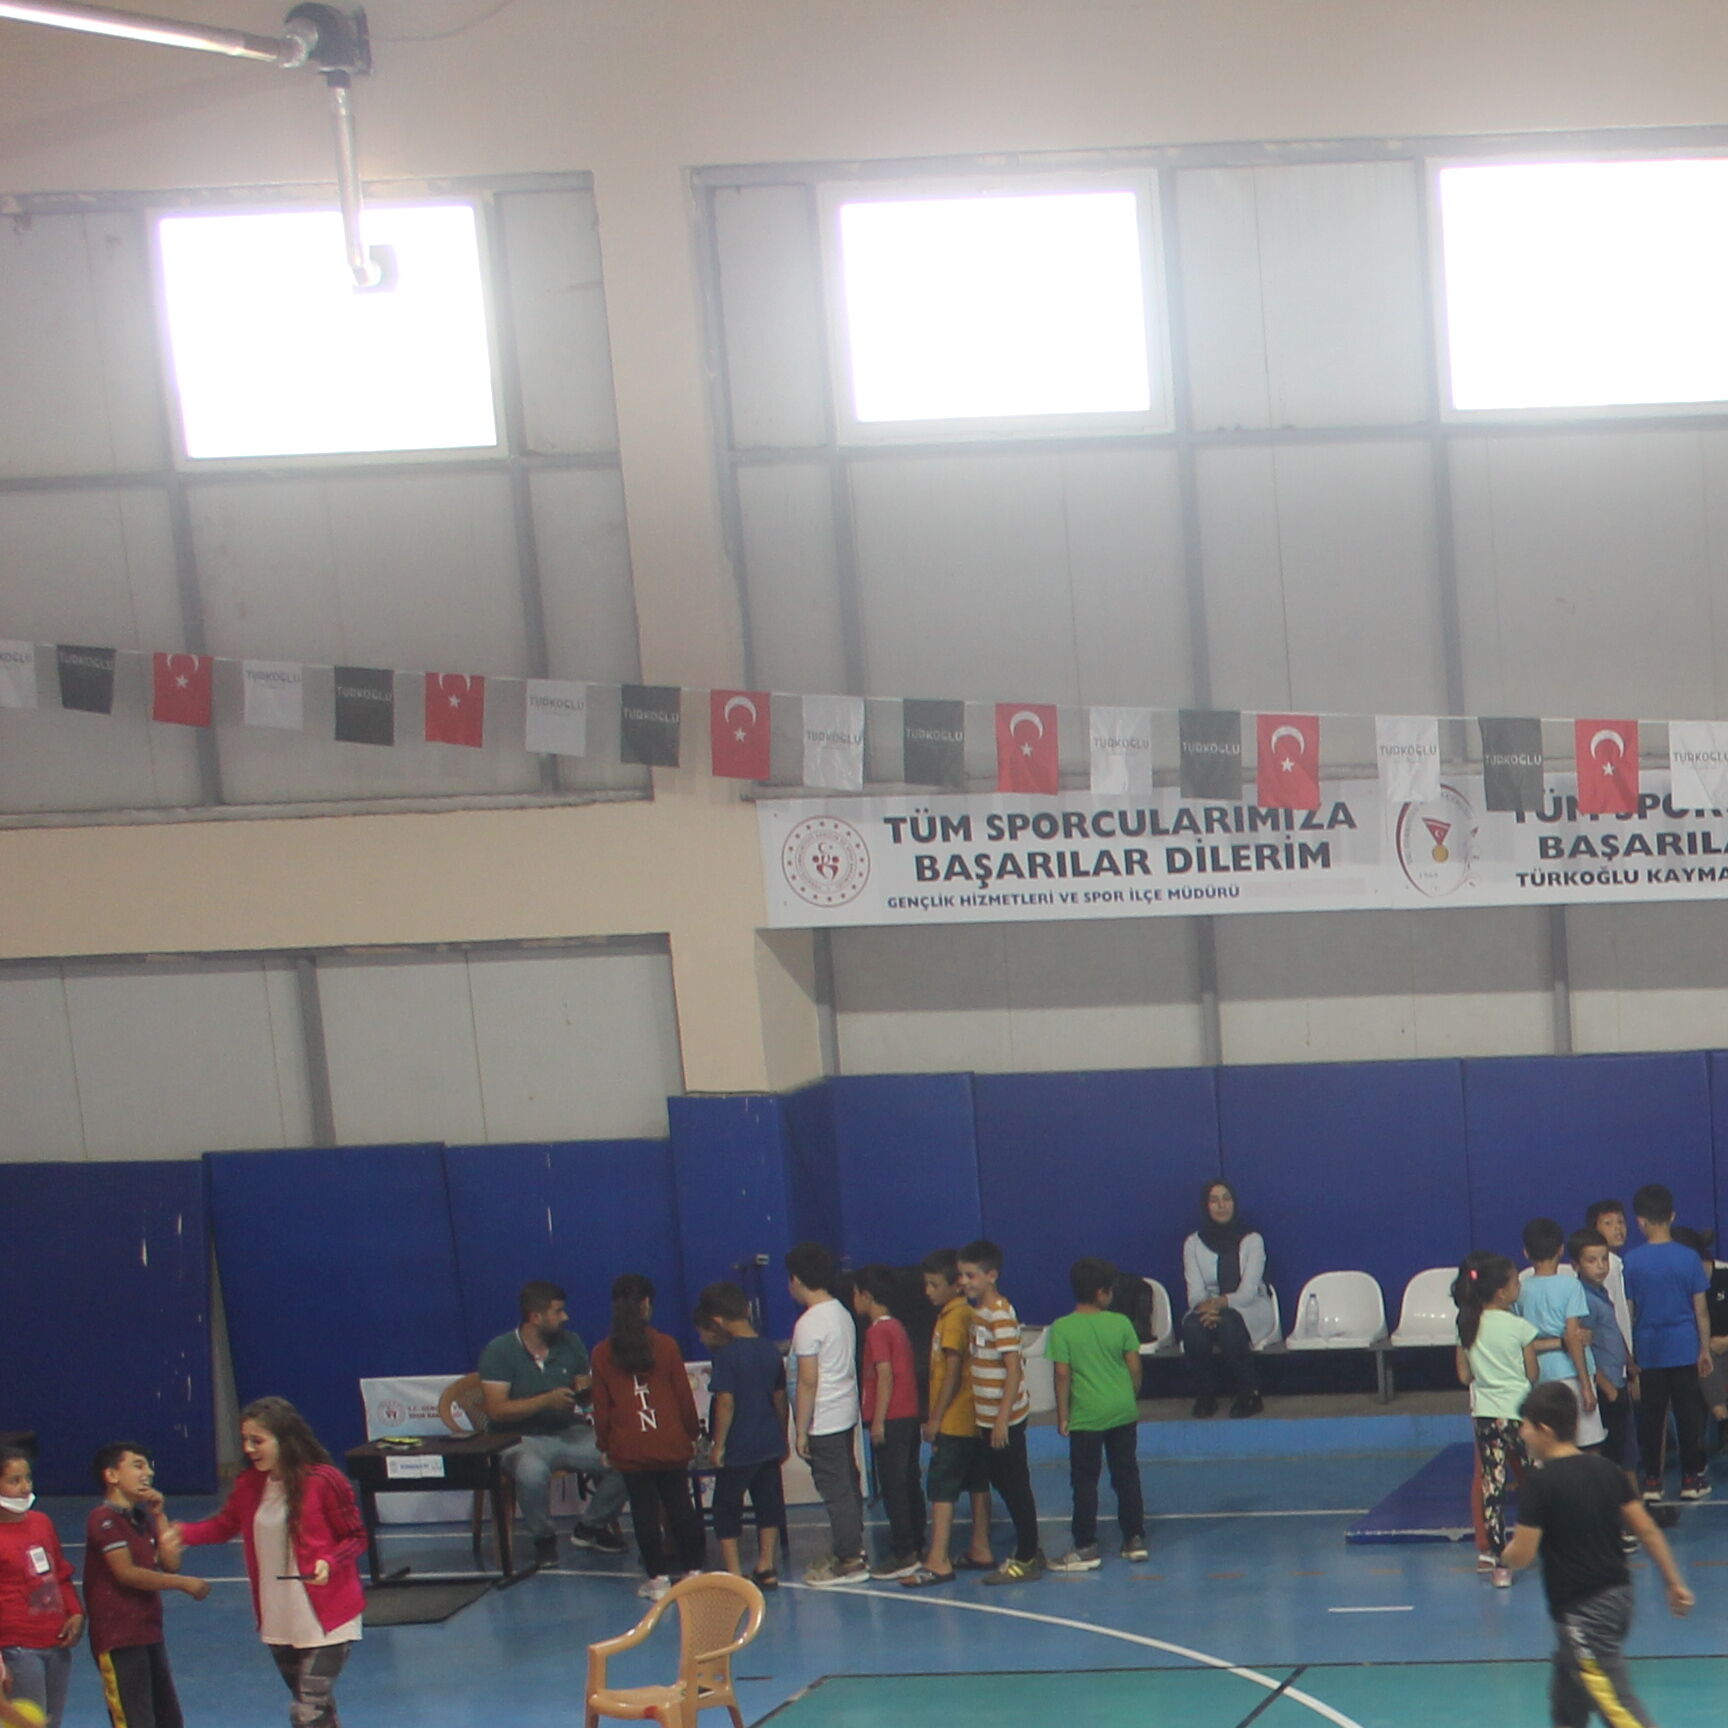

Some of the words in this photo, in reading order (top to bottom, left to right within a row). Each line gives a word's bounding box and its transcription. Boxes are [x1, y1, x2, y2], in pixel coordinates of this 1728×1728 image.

[884, 808, 974, 845] TÜM
[986, 801, 1358, 842] SPORCULARIMIZA
[914, 847, 1152, 888] BAŞARILAR
[1166, 834, 1332, 875] DİLERİM
[1515, 866, 1640, 889] TÜRKOĞLU
[887, 893, 955, 911] GENÇLİK
[959, 889, 1055, 907] HİZMETLERİ
[1058, 891, 1081, 906] VE
[1083, 889, 1125, 905] SPOR
[1129, 886, 1163, 904] İLÇE
[1167, 884, 1241, 901] MÜDÜRÜ
